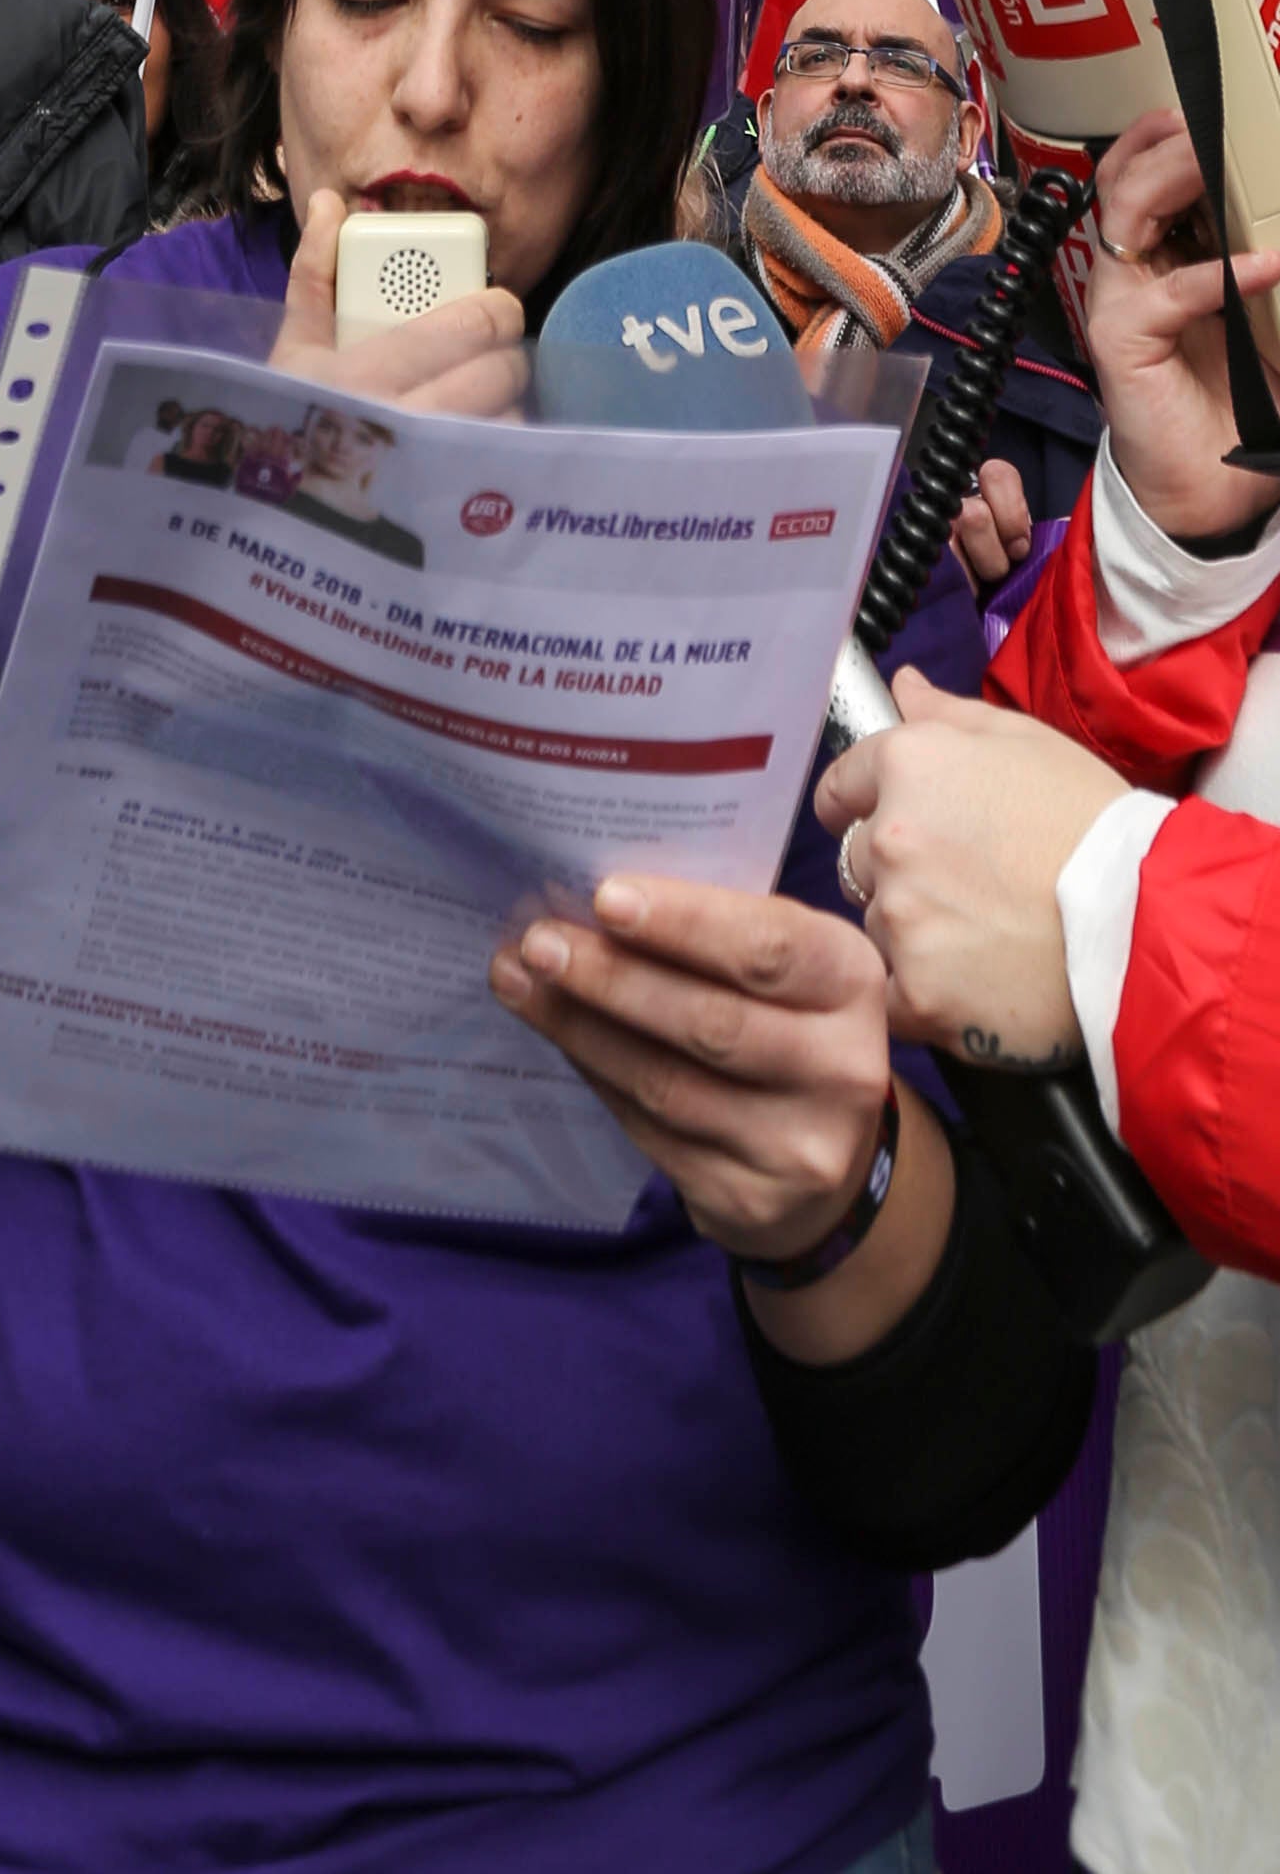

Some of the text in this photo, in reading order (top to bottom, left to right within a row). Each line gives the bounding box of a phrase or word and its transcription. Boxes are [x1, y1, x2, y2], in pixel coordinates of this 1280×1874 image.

[621, 295, 769, 374] tve
[468, 498, 832, 542] UGT #VivasLibresUnidas CCOO
[167, 514, 182, 533] 8
[189, 518, 220, 545] DE
[228, 531, 306, 581] MARZO
[312, 569, 362, 608] 2018
[386, 603, 424, 631] DIA
[431, 617, 605, 662] INTERNACIONAL
[614, 639, 642, 663] DE
[650, 641, 677, 665] LA
[684, 641, 752, 665] MUJER
[248, 571, 664, 698] #VivasLibresUnidas POR LA IGUALDAD
[448, 721, 512, 749] HUELGA
[514, 739, 535, 752] DE
[538, 742, 572, 758] DOS
[574, 748, 630, 765] HORAS
